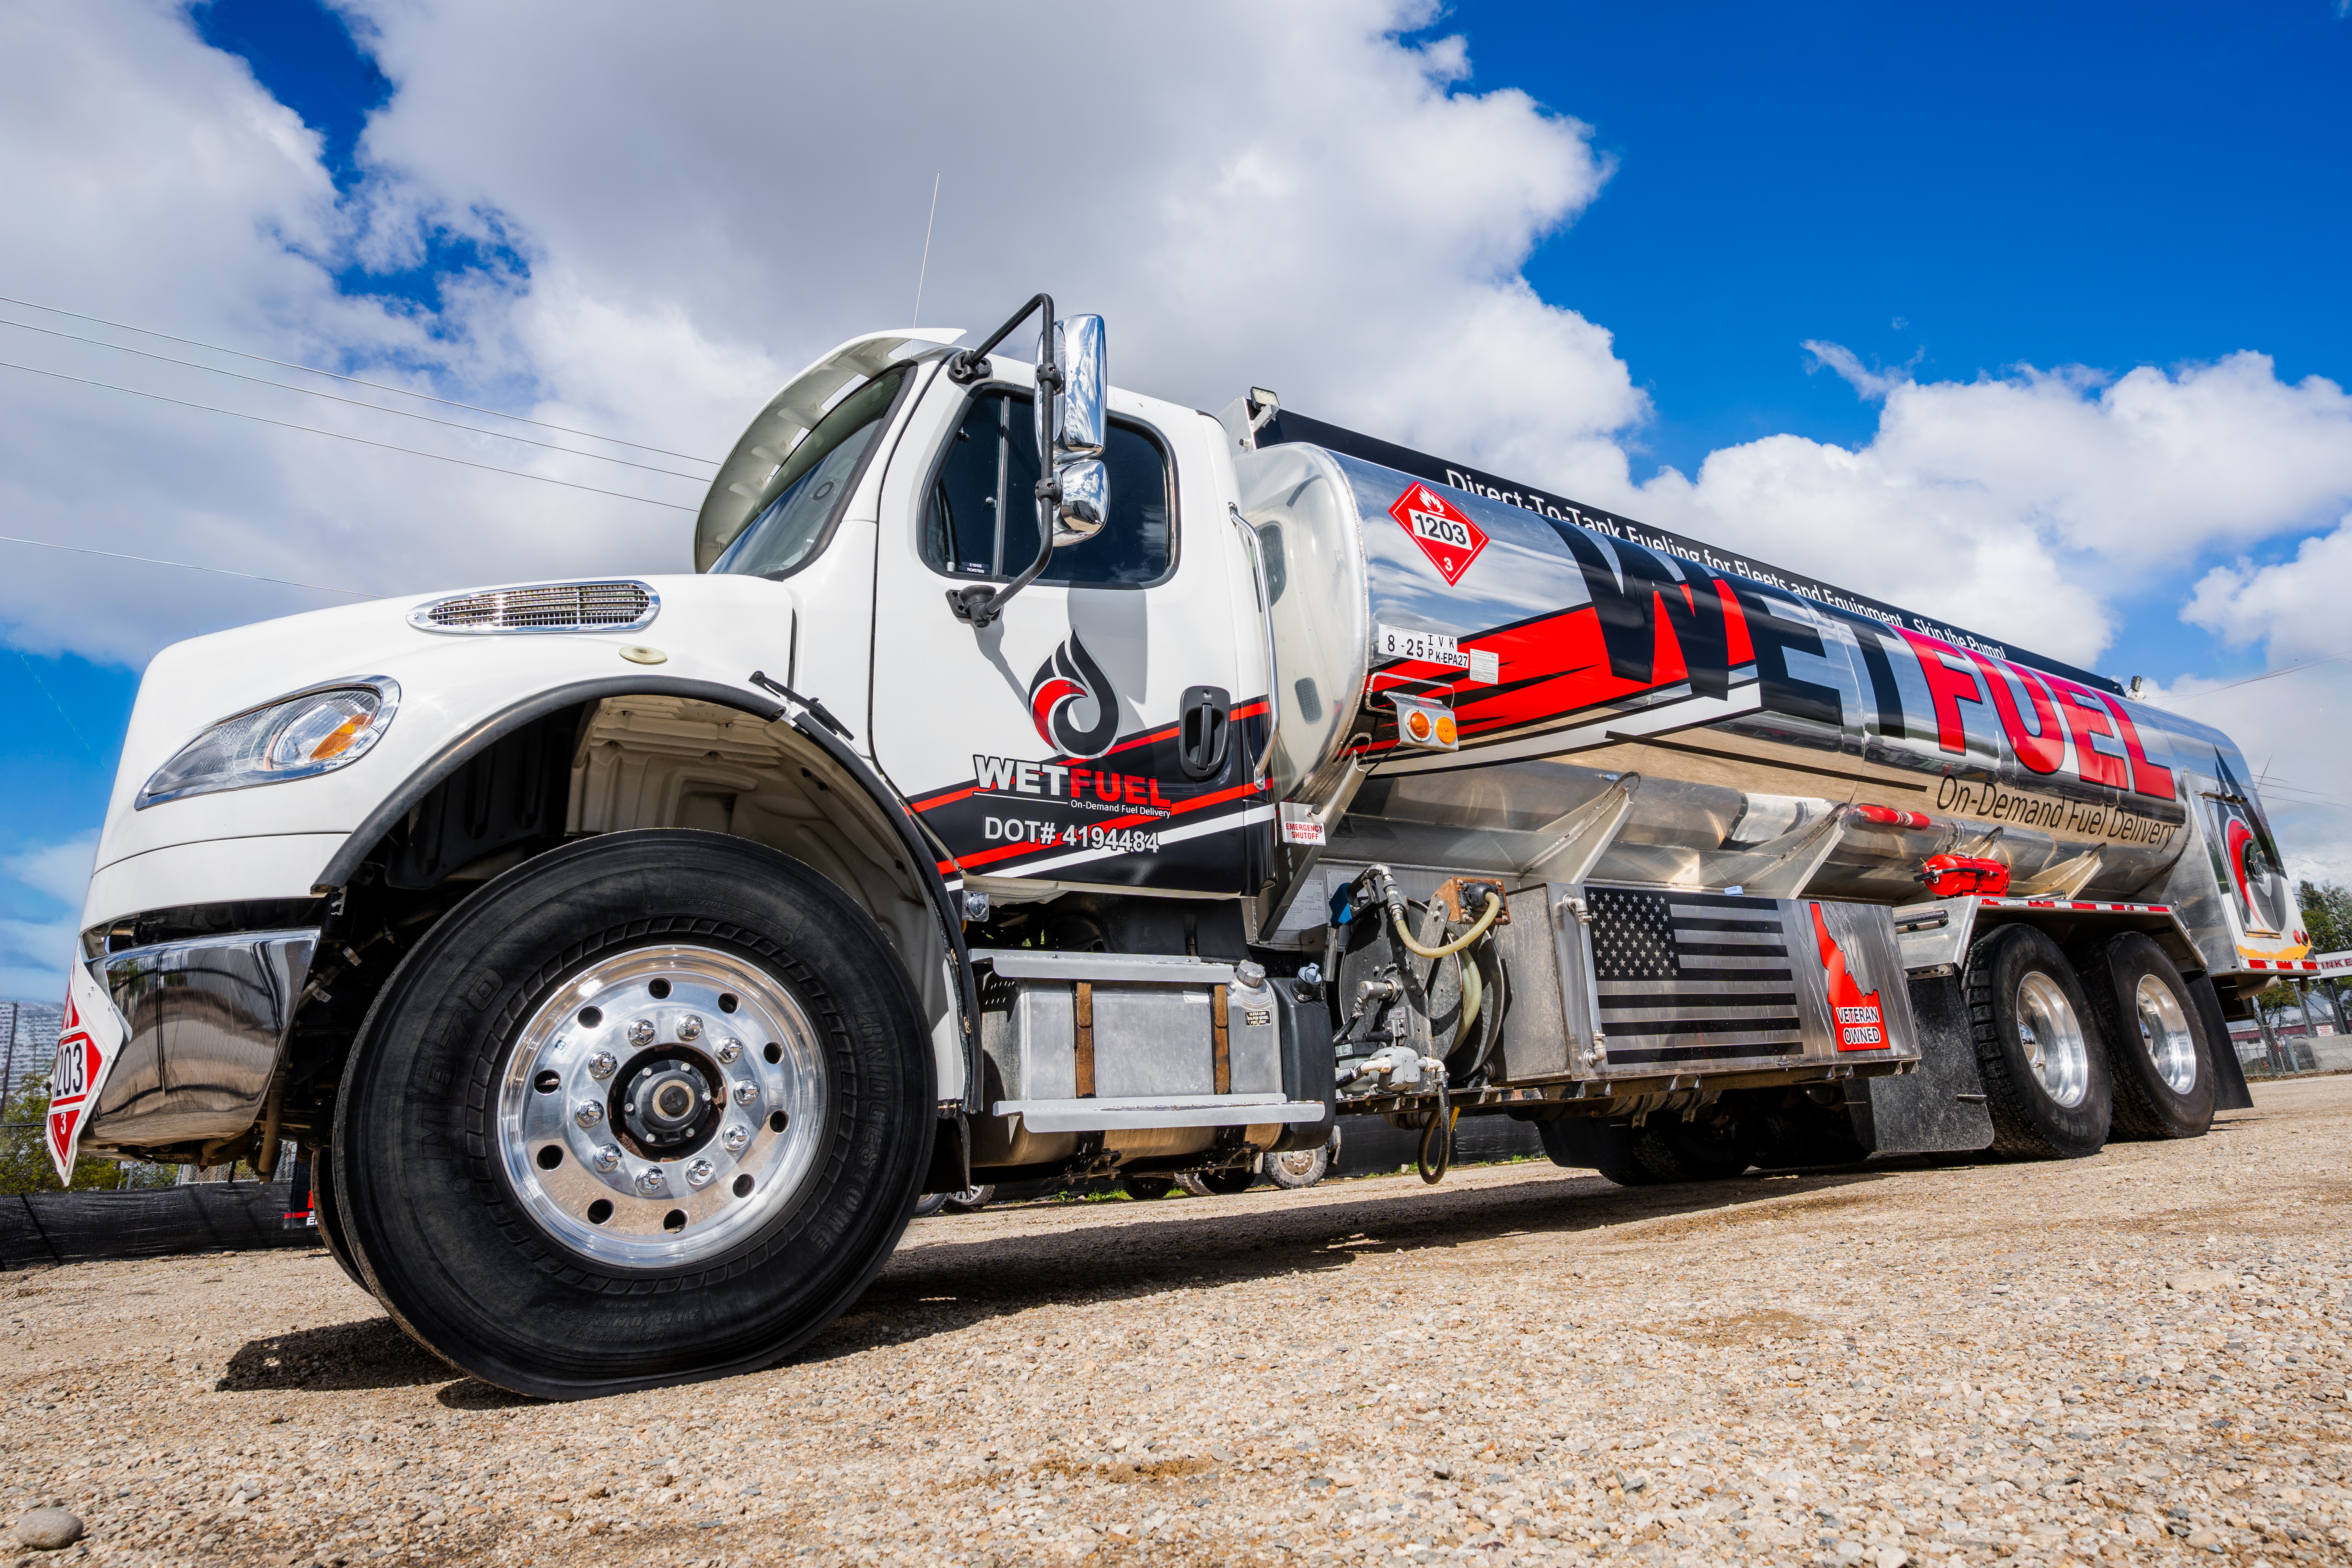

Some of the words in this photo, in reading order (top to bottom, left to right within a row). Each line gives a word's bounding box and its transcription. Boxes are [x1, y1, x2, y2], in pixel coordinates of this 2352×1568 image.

[1414, 513, 1466, 546] 1203
[1444, 558, 1453, 571] 3
[1704, 549, 1730, 572] for
[1436, 651, 1468, 667] K-EPA27
[1071, 800, 1119, 812] On-Demand
[1122, 805, 1138, 814] Fuel
[1140, 807, 1171, 819] Delivery
[1936, 774, 2065, 828] On-Demand
[2066, 799, 2108, 836] Fuel
[2107, 808, 2178, 853] Delivery
[985, 816, 1056, 844] DOT#
[1062, 824, 1159, 853] 4194484
[1286, 823, 1322, 832] EMERGENCY
[1292, 831, 1318, 840] SHUTOFF
[677, 898, 731, 912] REGROOVABLE
[2318, 958, 2352, 971] INKE
[1836, 1007, 1880, 1023] VETERAN
[1844, 1027, 1880, 1044] OWNED
[561, 1041, 572, 1056] ALCOA
[60, 1112, 67, 1135] 3
[812, 1011, 892, 1256] BRIDGESTONE
[597, 1300, 651, 1308] RADIAL
[540, 1301, 701, 1328] 315/80R22.5
[566, 1330, 629, 1342] PROFILE
[633, 1332, 665, 1342] LOW
